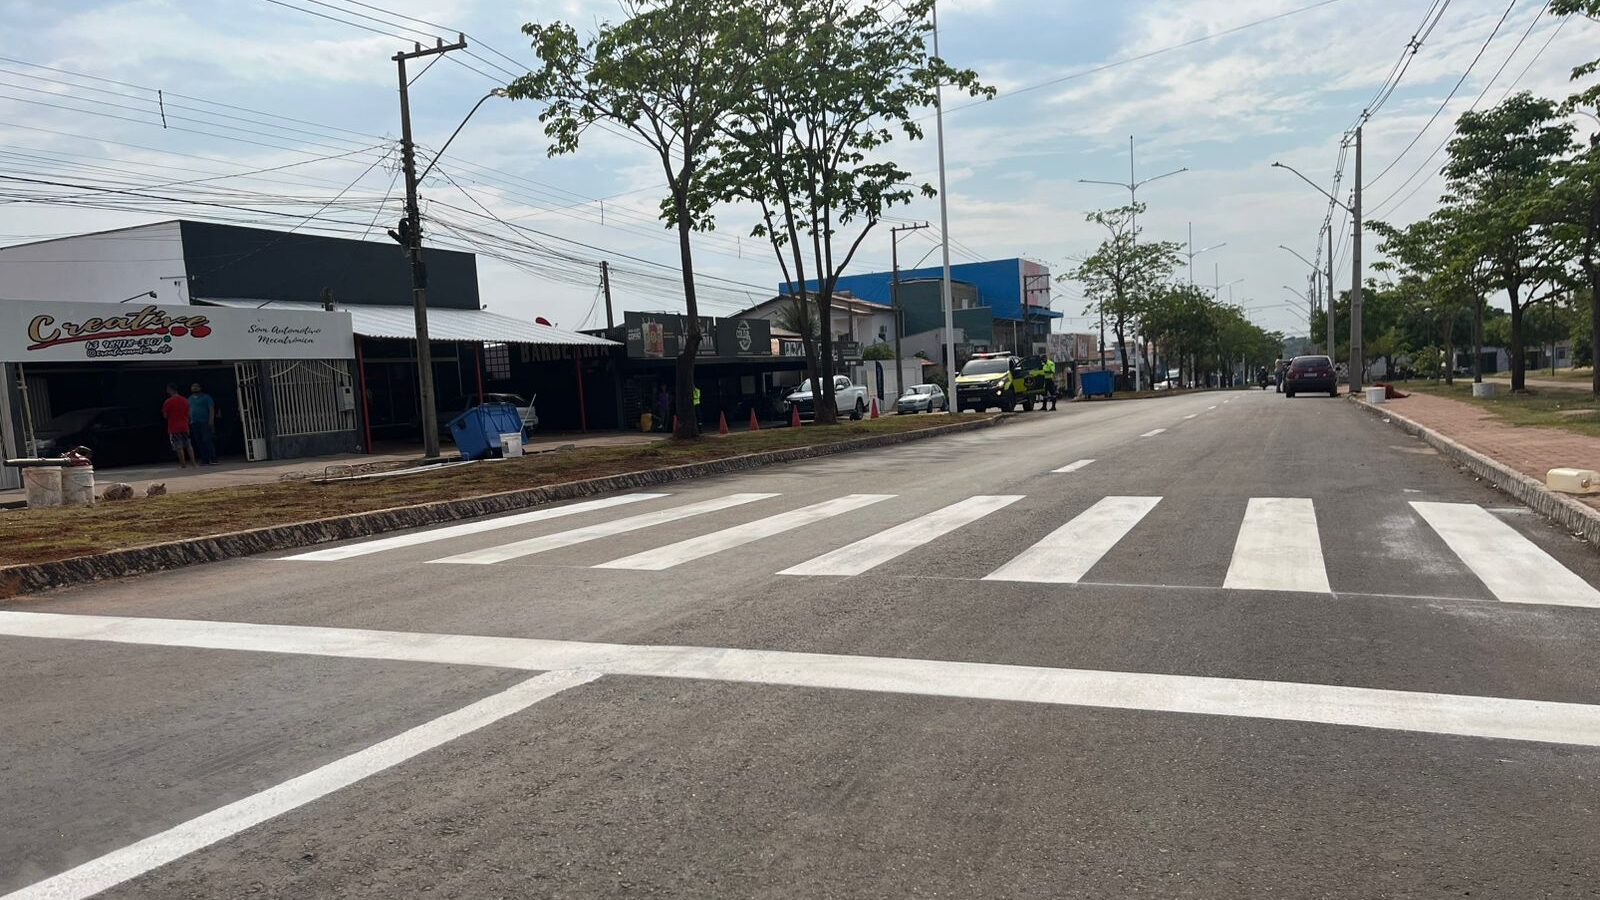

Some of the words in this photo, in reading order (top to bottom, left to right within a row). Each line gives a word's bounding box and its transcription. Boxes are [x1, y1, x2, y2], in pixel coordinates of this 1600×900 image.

[28, 305, 210, 343] Creative
[248, 324, 268, 334] Som
[271, 325, 321, 334] Automotivo
